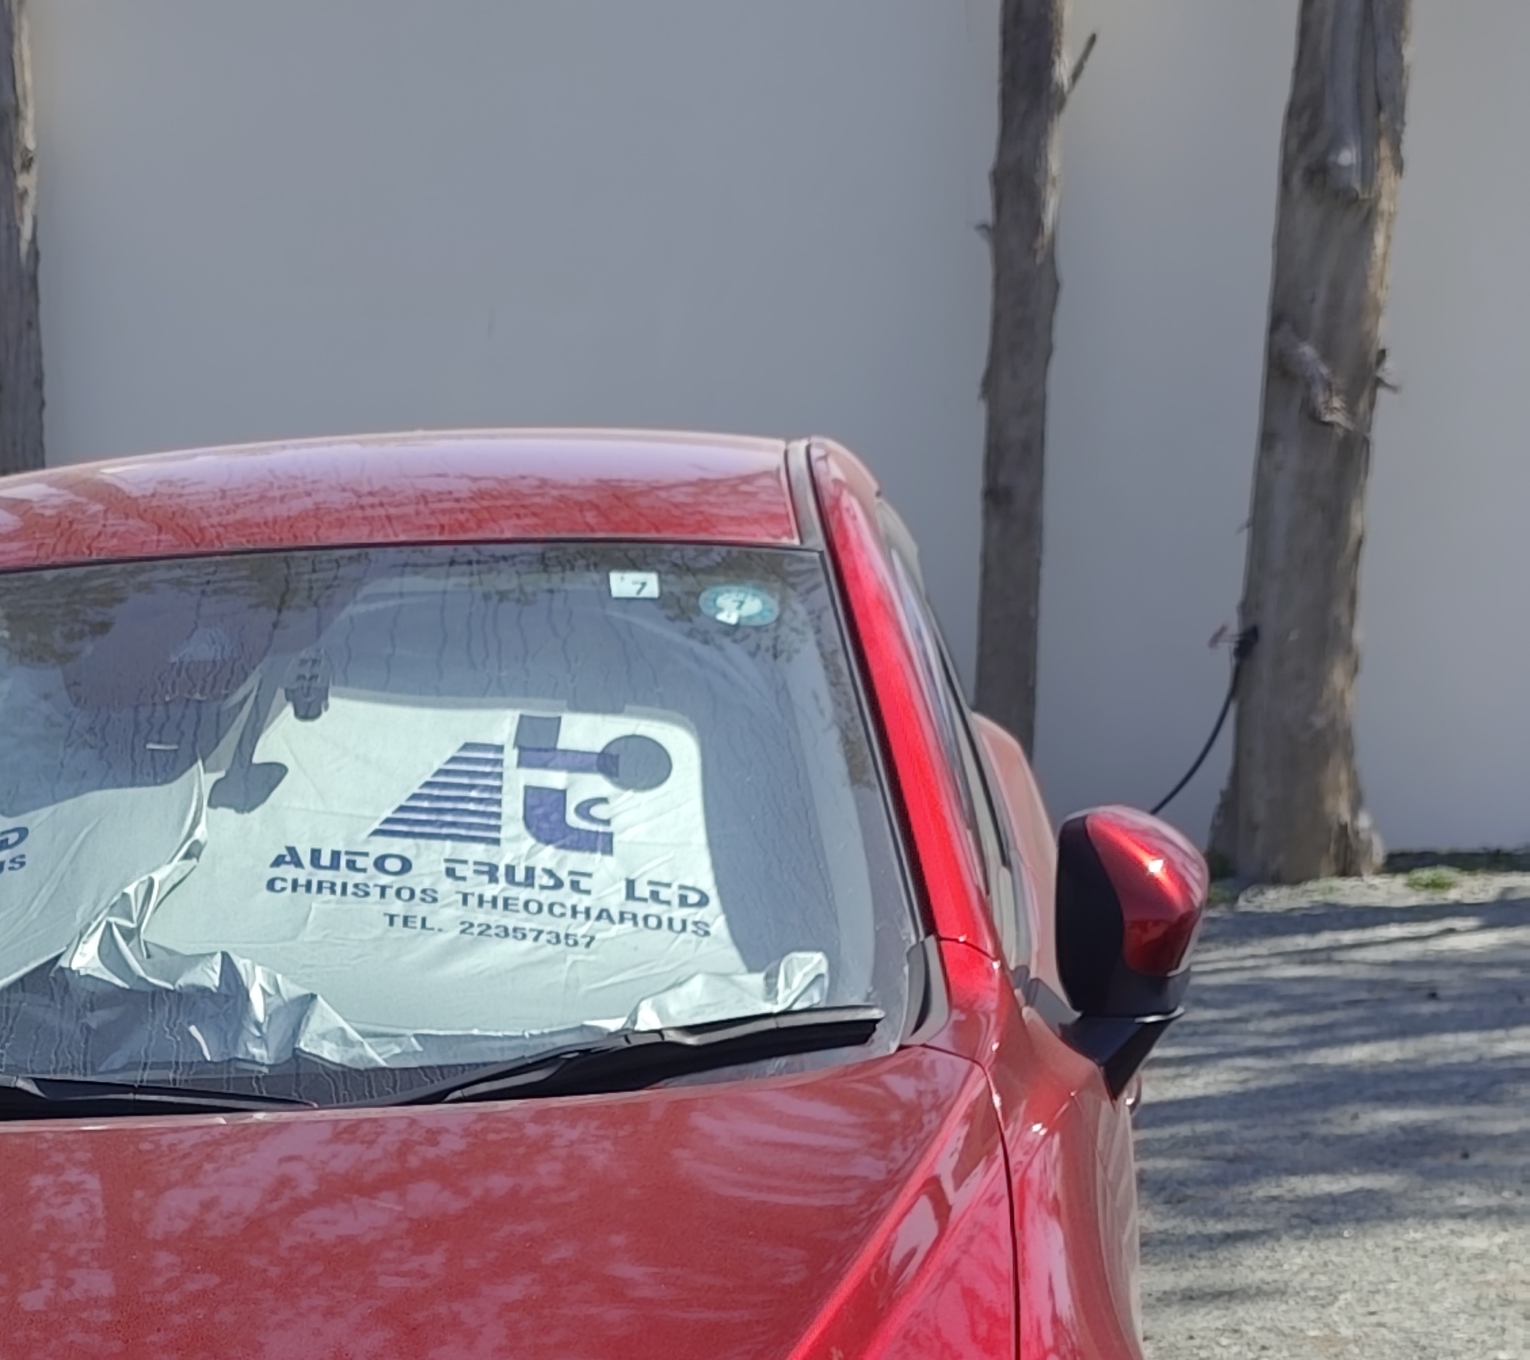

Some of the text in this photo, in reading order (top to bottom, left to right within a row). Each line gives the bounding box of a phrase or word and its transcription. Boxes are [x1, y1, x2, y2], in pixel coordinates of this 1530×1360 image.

[631, 580, 648, 596] 7
[269, 845, 710, 909] AUTO TRUST LTD
[266, 876, 712, 938] CHRISTOS THEOCHAROUS
[384, 912, 597, 950] TEL. 22357357
